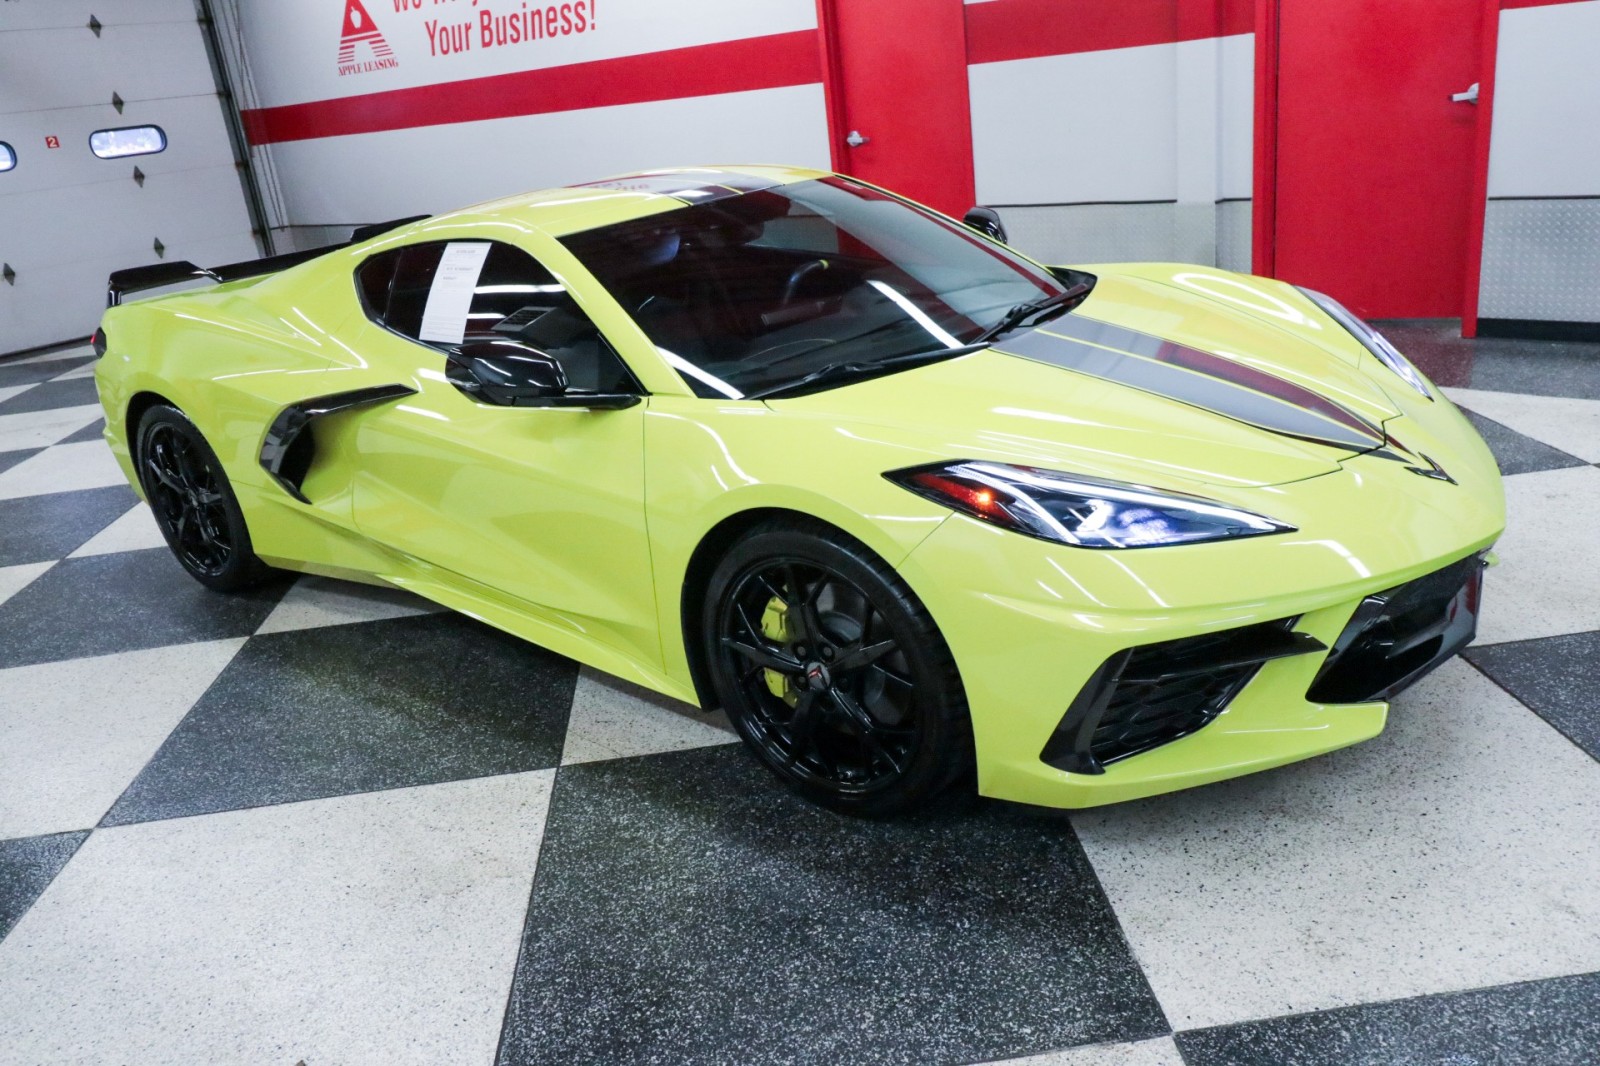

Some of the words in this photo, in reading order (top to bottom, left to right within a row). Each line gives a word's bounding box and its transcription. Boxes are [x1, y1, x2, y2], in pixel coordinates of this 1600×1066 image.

[424, 19, 472, 56] Your
[479, 0, 596, 48] Business!
[338, 63, 363, 76] APPLE
[364, 57, 399, 72] LEASING
[47, 137, 58, 148] 2
